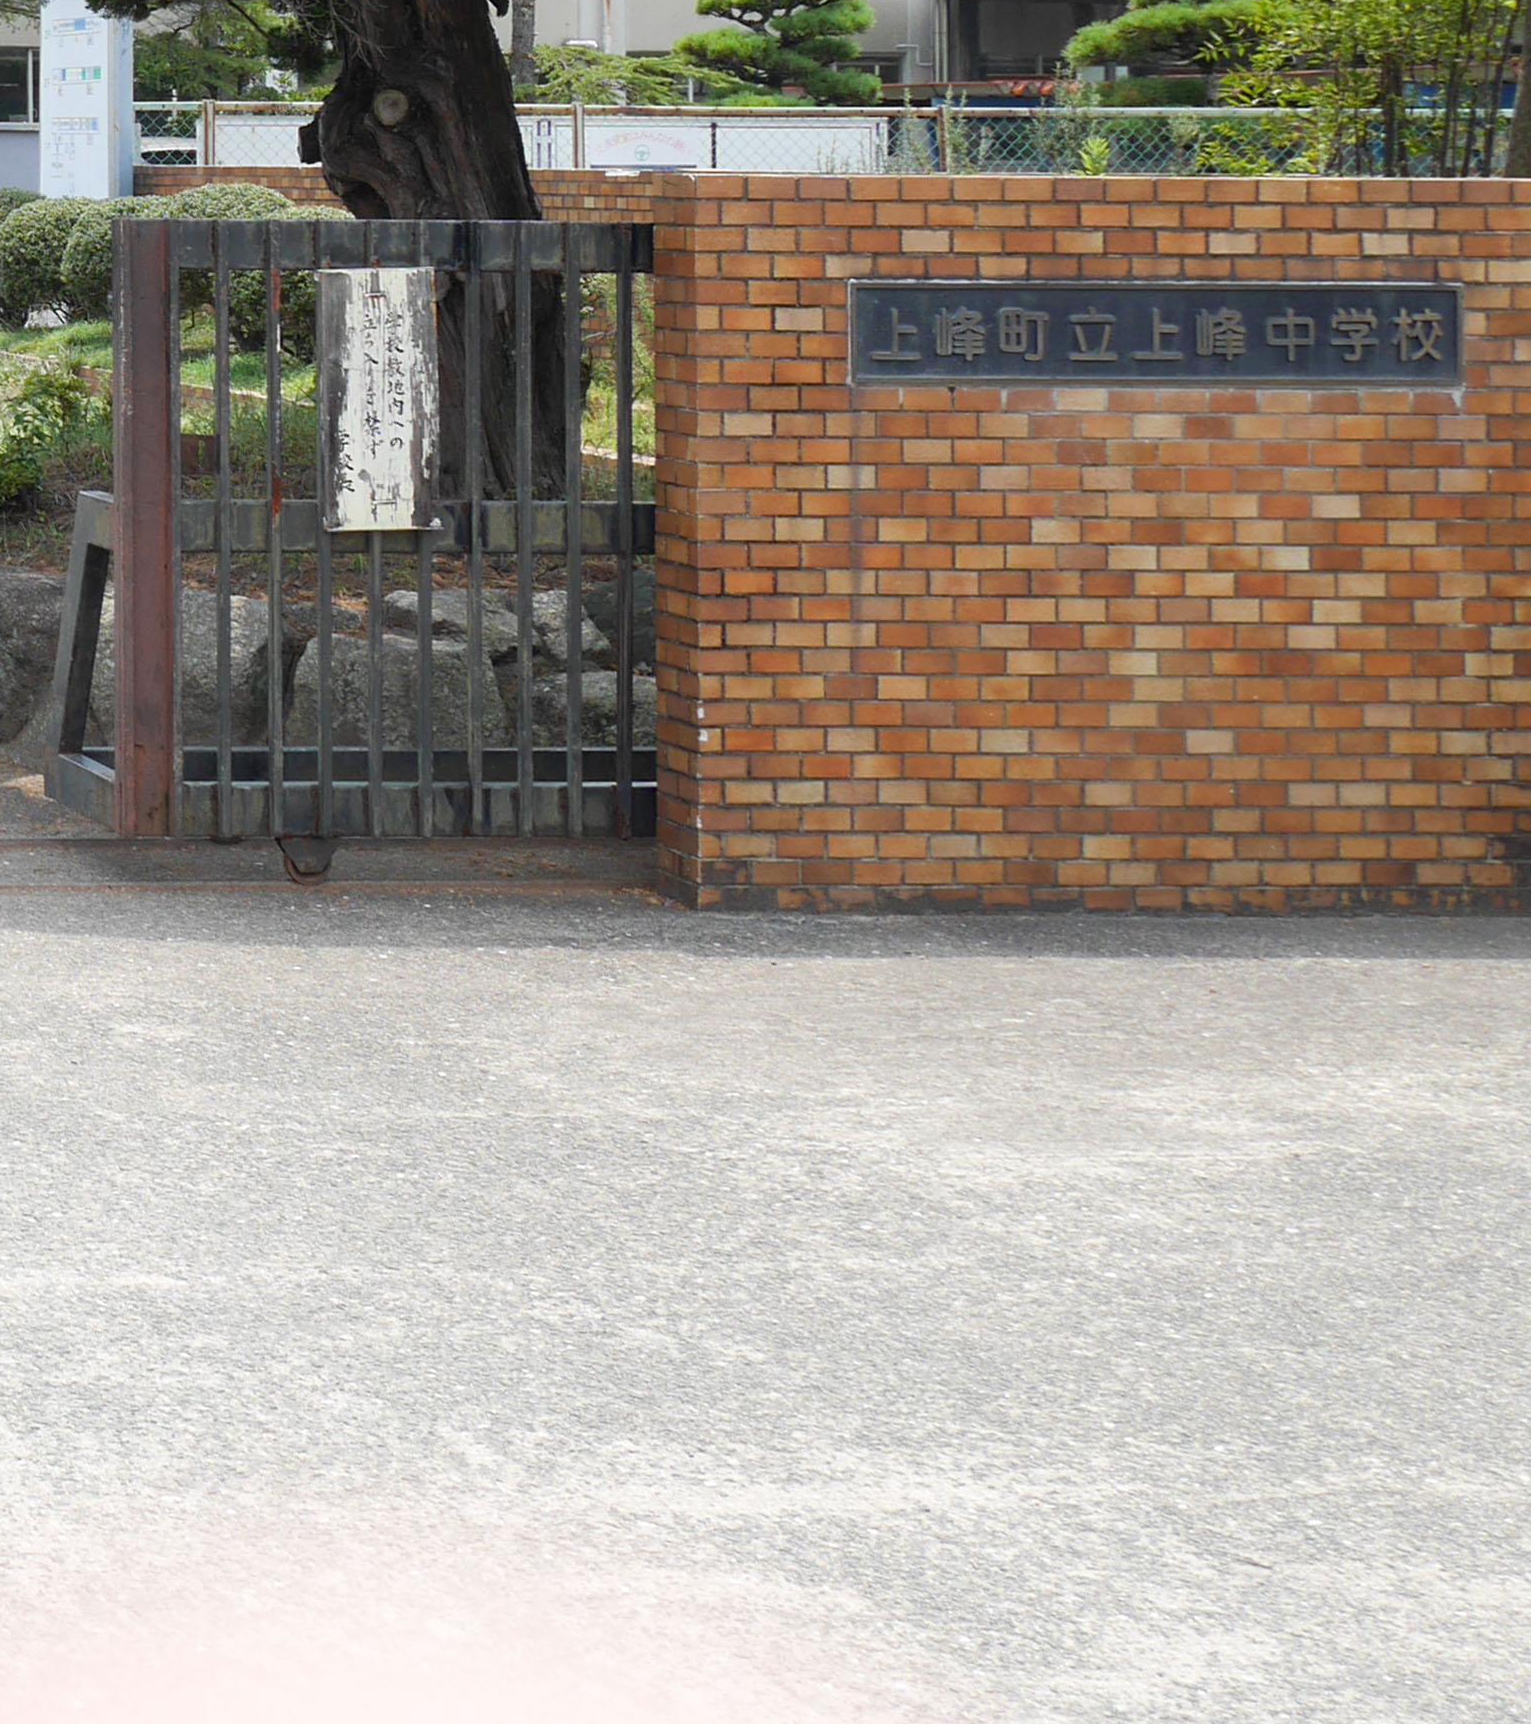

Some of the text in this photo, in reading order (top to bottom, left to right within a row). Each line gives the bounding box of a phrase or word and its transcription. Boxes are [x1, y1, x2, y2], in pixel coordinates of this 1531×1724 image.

[871, 307, 1443, 362] 上峰町立上峰中学校
